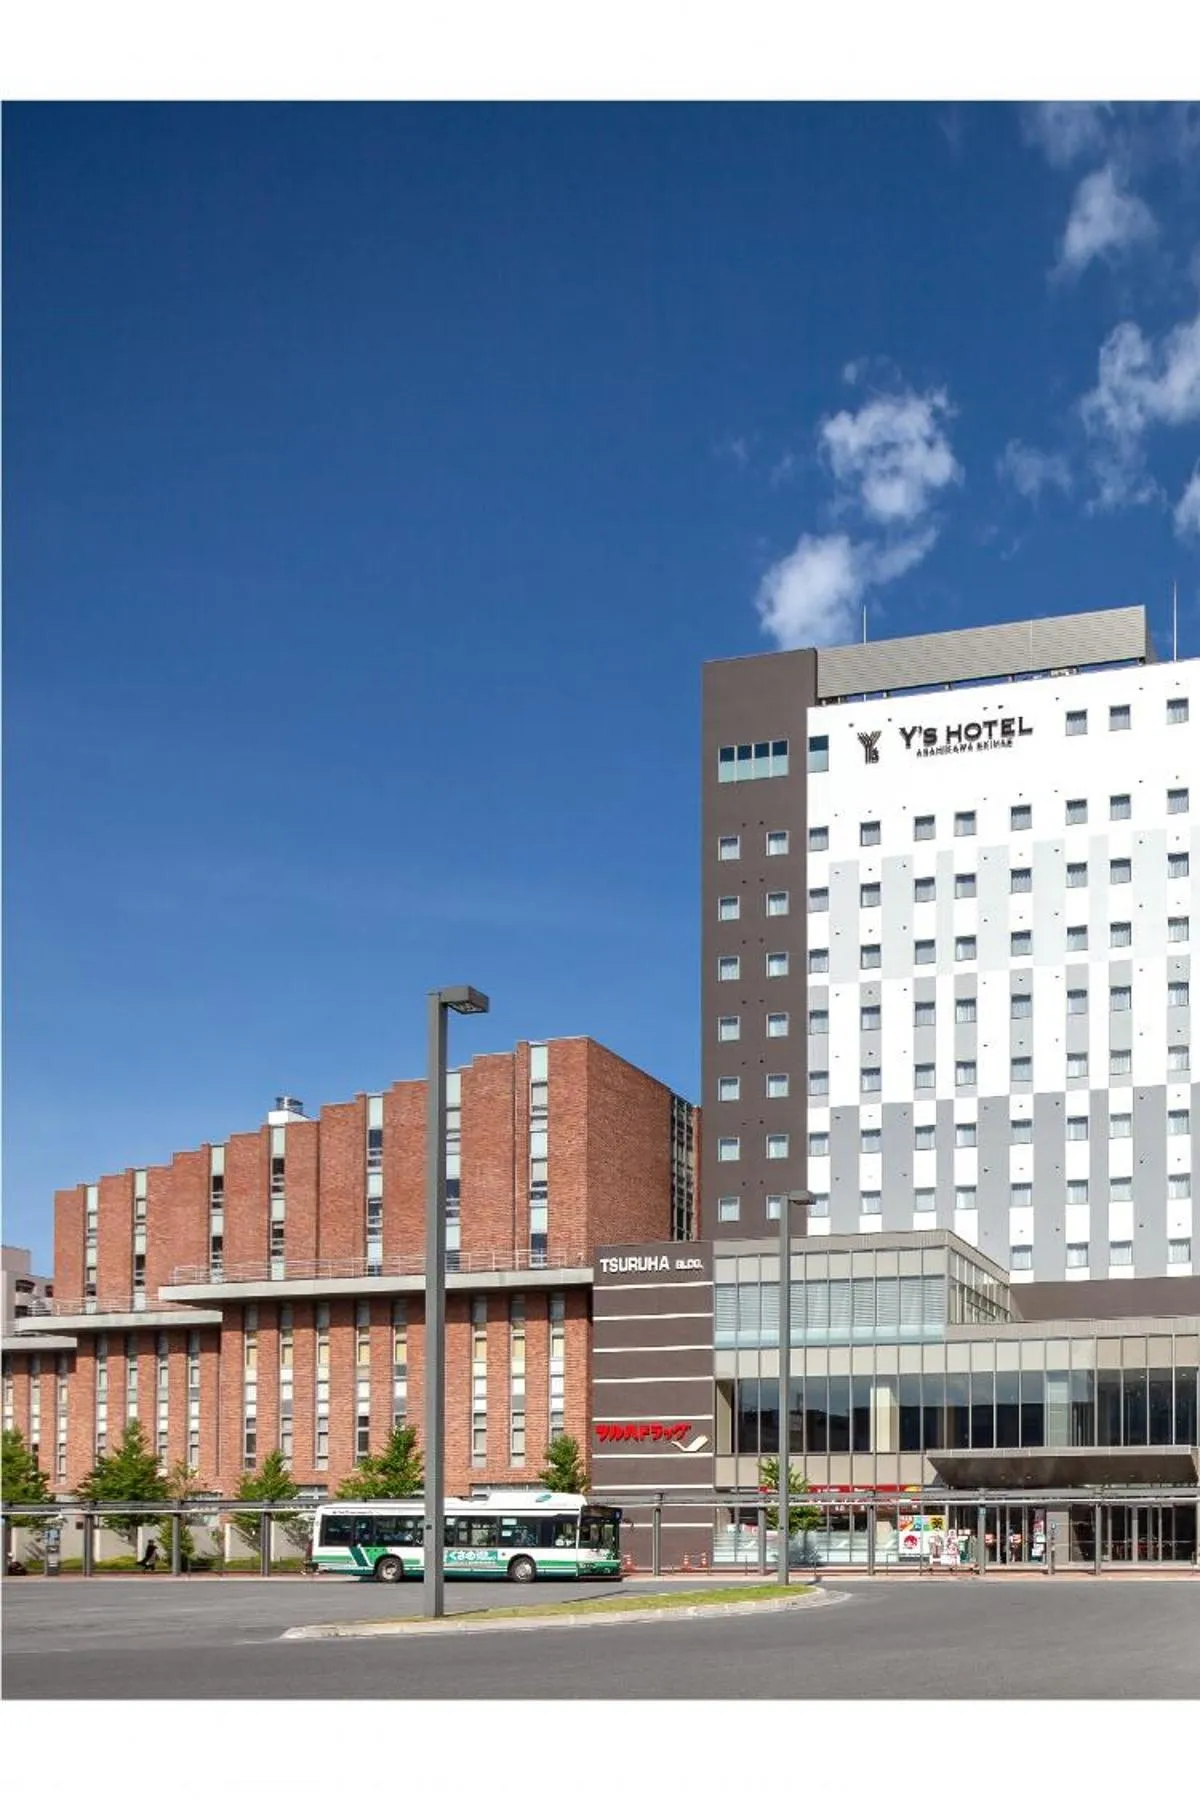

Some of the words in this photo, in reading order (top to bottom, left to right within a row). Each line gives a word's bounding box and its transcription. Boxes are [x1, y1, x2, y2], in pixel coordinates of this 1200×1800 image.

[945, 716, 1034, 745] HOTEL
[600, 1256, 670, 1273] TSURUHA
[595, 1423, 692, 1442] ツルハドラッグ
